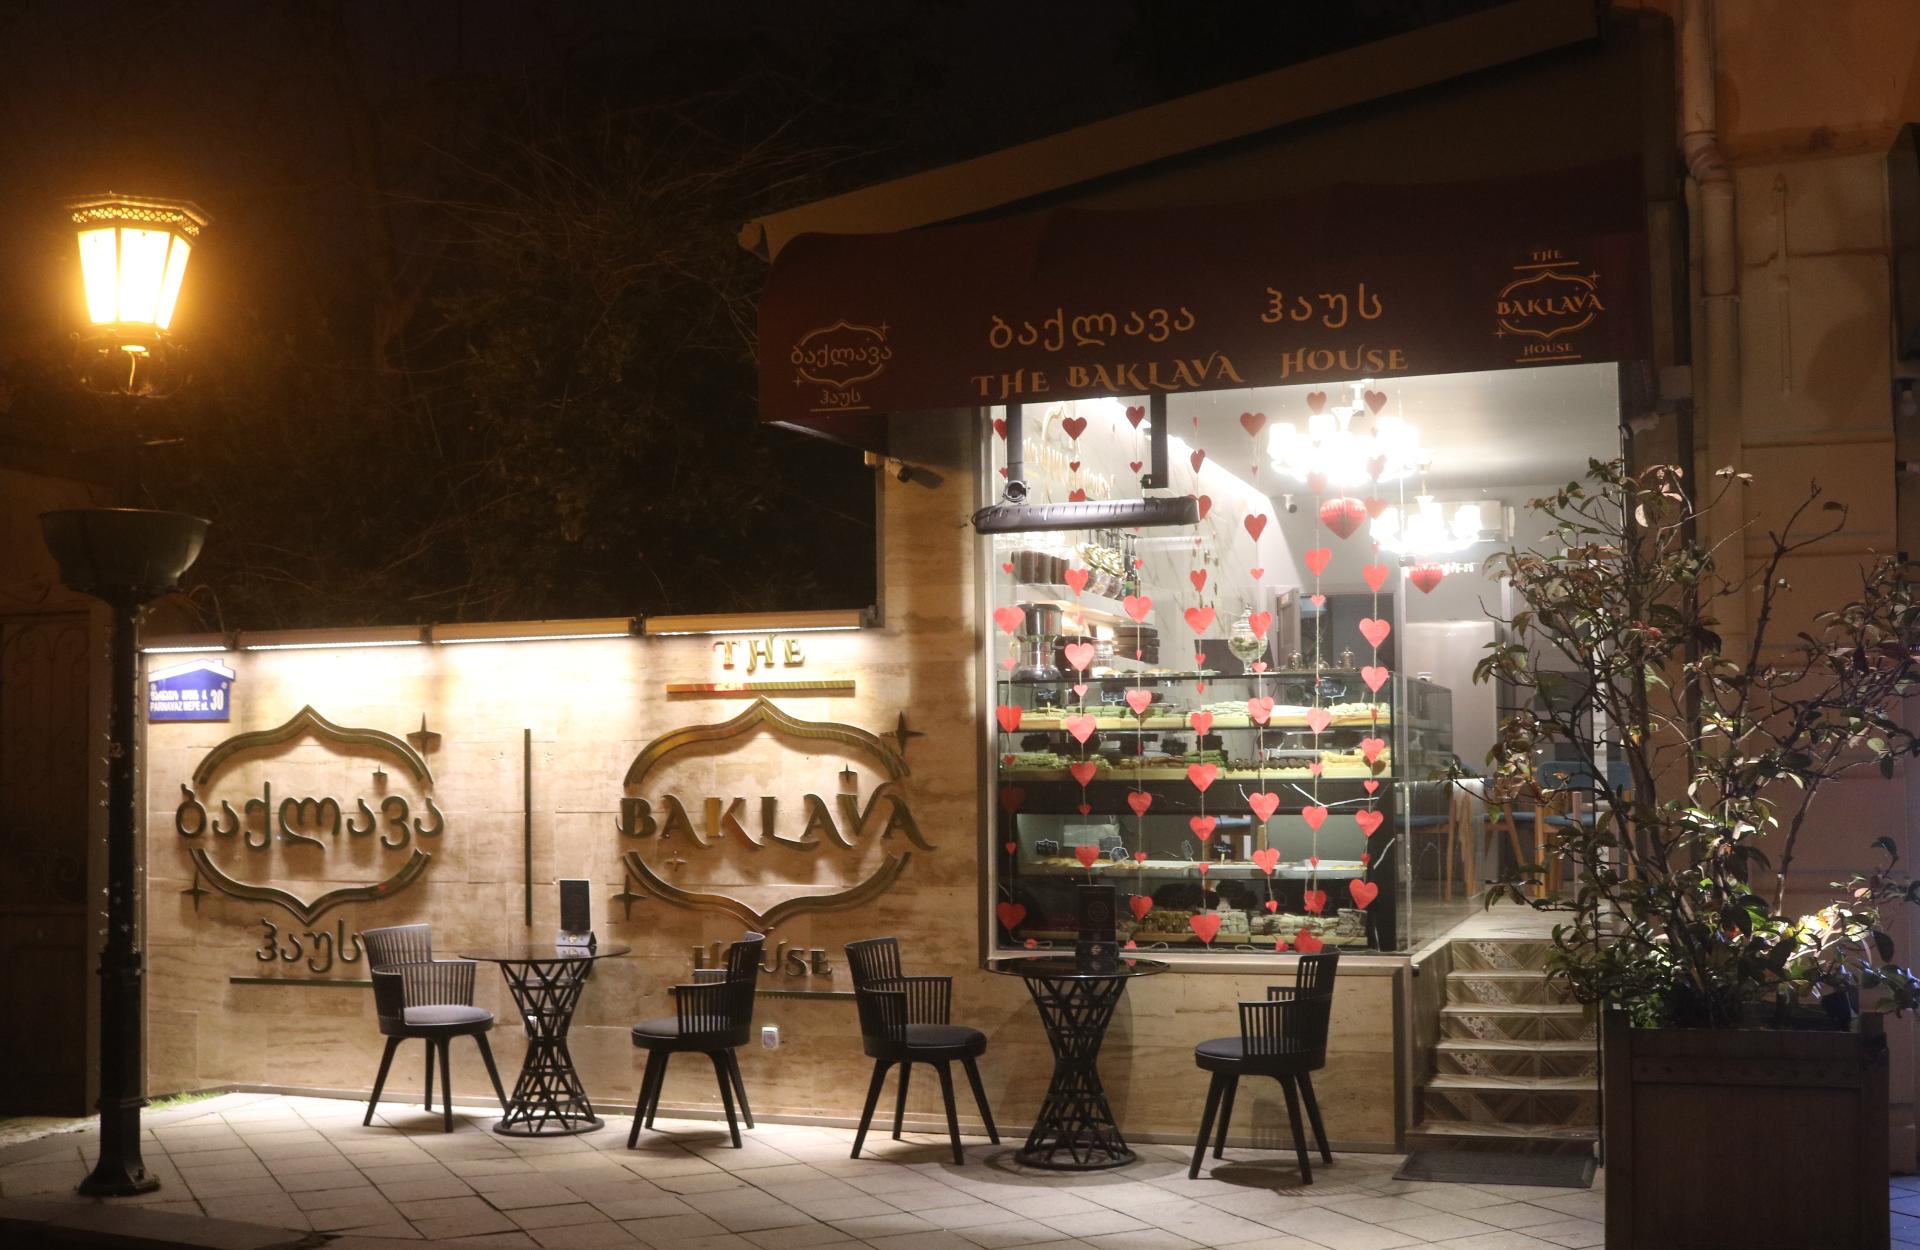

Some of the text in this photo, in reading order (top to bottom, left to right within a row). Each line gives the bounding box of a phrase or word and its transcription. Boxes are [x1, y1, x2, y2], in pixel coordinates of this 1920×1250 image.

[1531, 249, 1563, 261] THE
[988, 281, 1384, 352] ბაქლავა ჰაუს
[1496, 291, 1606, 317] BAKLAVA
[790, 343, 893, 368] ბაქლავა
[1523, 342, 1575, 356] HOUSE
[970, 343, 1409, 399] THE BAKLAVA HOUSE
[820, 386, 862, 408] ჰაუს
[713, 634, 806, 673] THE
[210, 689, 224, 711] 30
[176, 781, 444, 851] ბაქლავა
[615, 782, 938, 851] BAKLAVA
[256, 918, 363, 973] ჰაუს
[692, 940, 833, 977] HUSE
